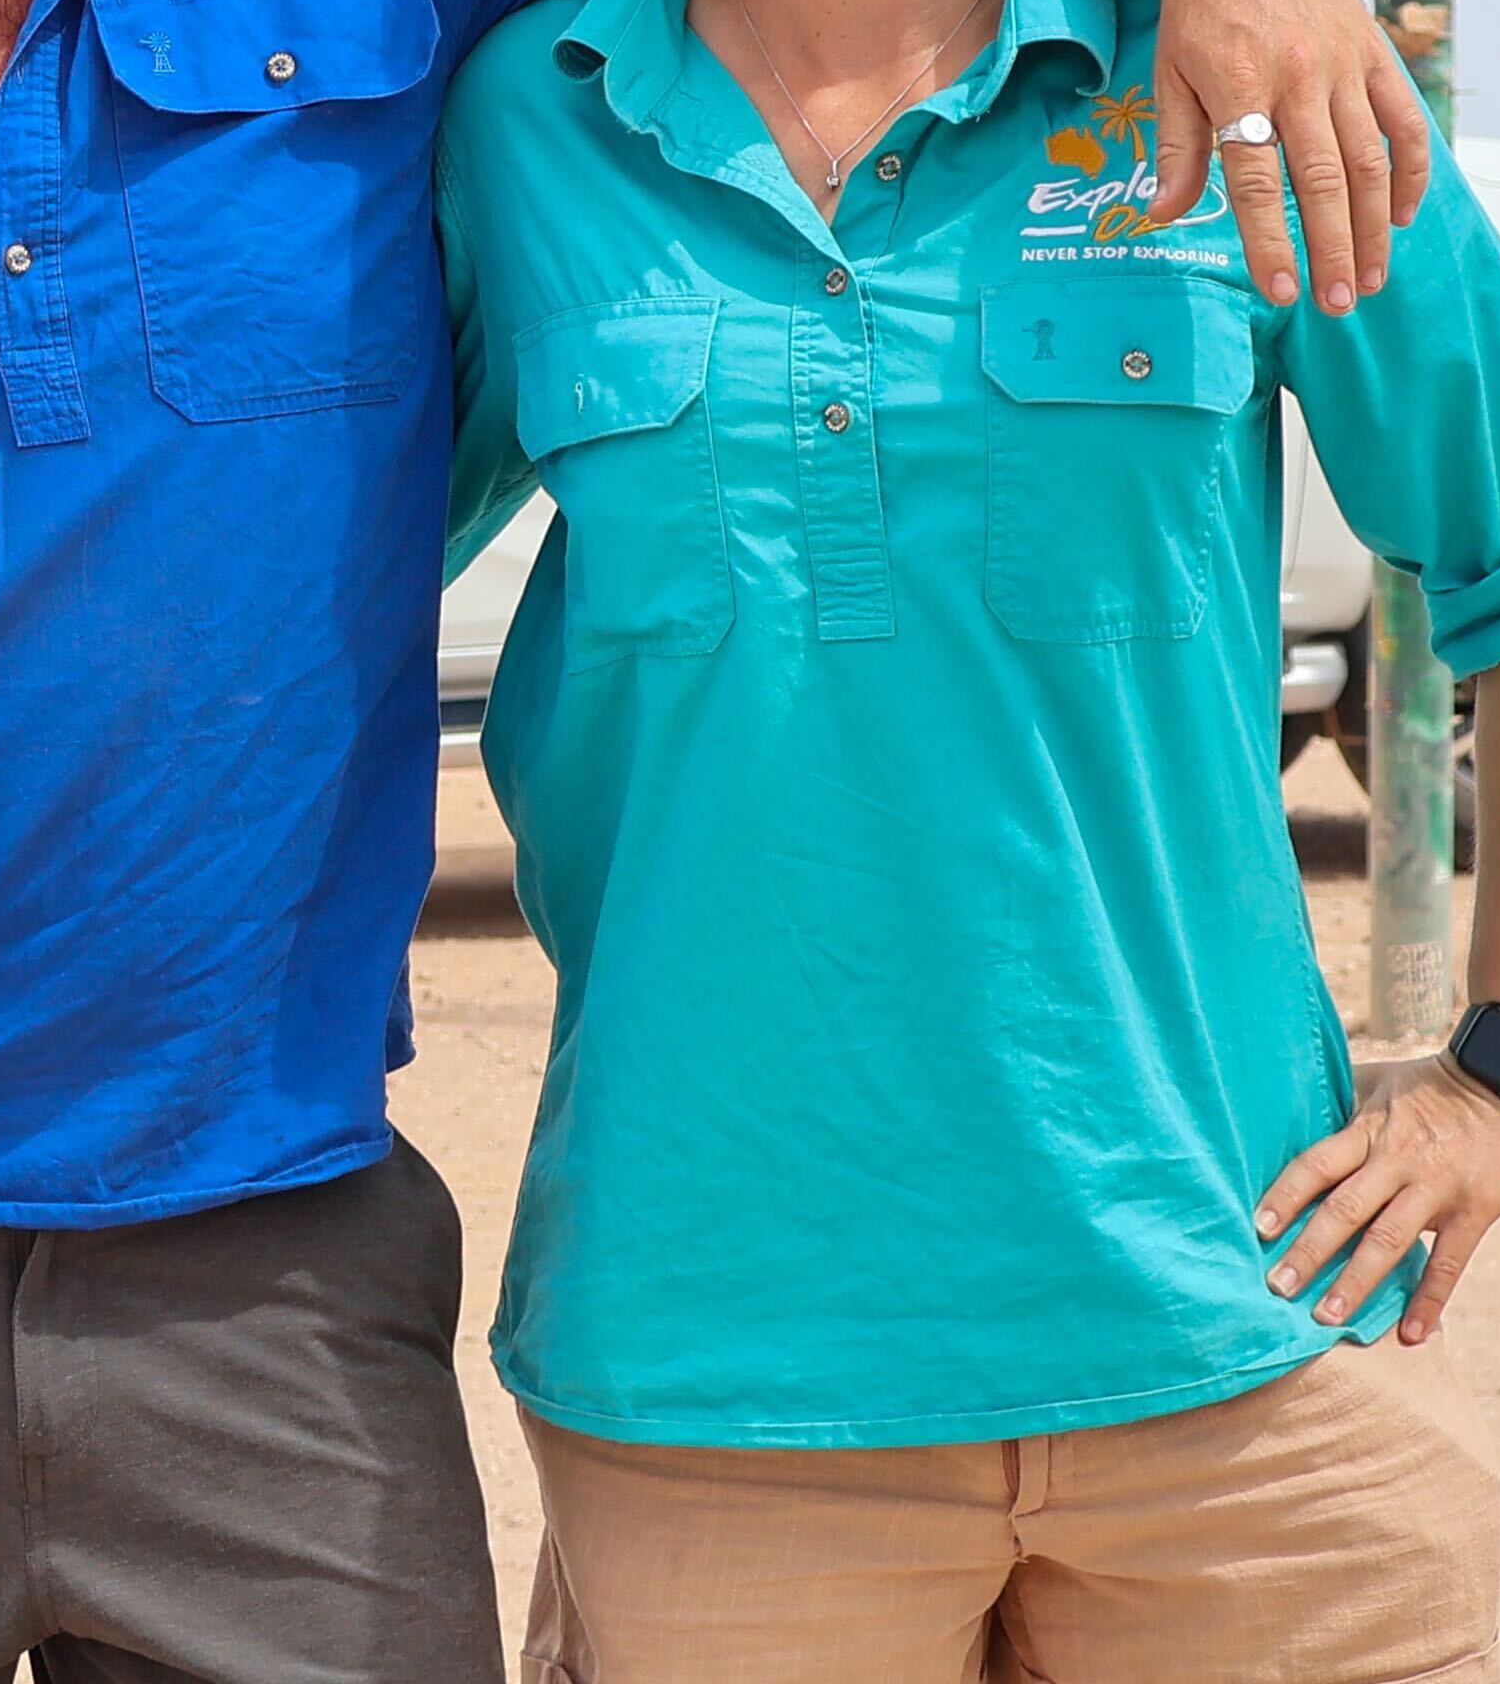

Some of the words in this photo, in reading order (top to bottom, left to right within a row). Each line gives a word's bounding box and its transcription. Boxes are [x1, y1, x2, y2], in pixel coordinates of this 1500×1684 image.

[1027, 160, 1158, 220] Explo
[1021, 246, 1079, 262] NEVER
[1083, 245, 1129, 261] STOP
[1133, 245, 1230, 267] EXPLORING
